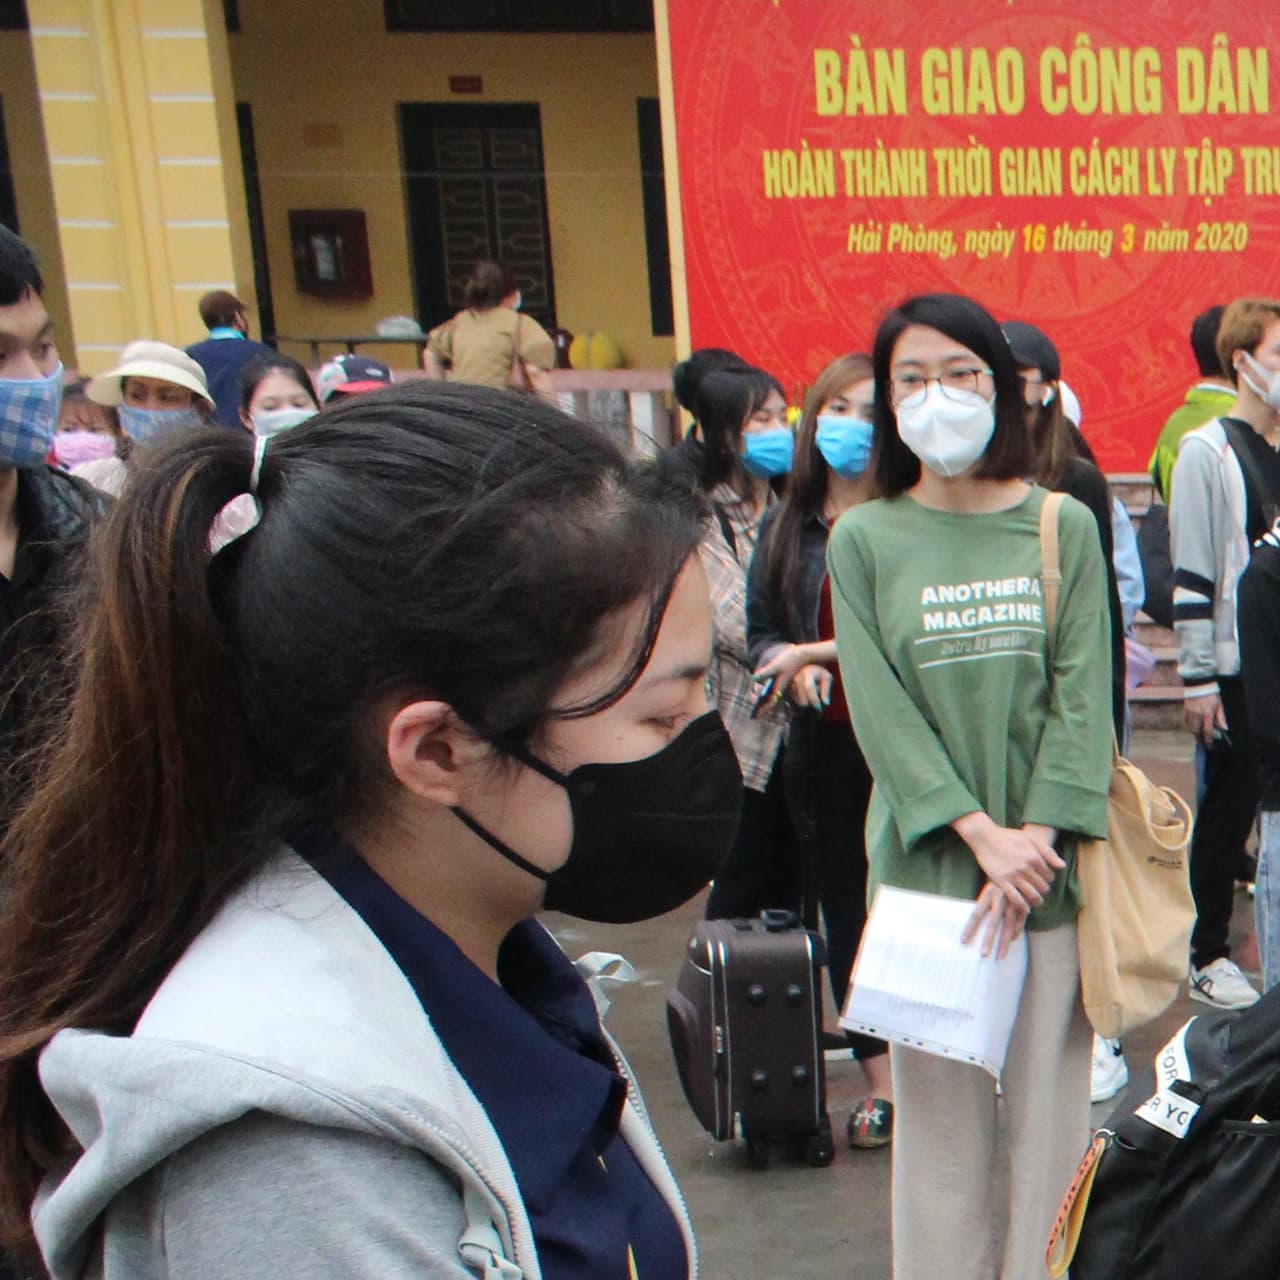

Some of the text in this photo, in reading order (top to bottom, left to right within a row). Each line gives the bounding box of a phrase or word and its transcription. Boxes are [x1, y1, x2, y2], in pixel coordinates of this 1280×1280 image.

[814, 32, 1269, 115] BÀN GIAO CÔNG DÂN
[763, 138, 836, 198] HOÀN
[840, 138, 928, 198] THÀNH
[933, 134, 992, 197] THỜI
[1000, 147, 1062, 196] GIAN
[1070, 137, 1140, 196] CÁCH
[1146, 148, 1176, 196] LY
[1184, 137, 1233, 206] TẬP
[848, 218, 1248, 259] Hải Phòng, ngày 16 tháng 3 năm 2020
[923, 602, 1042, 632] MAGAZINE
